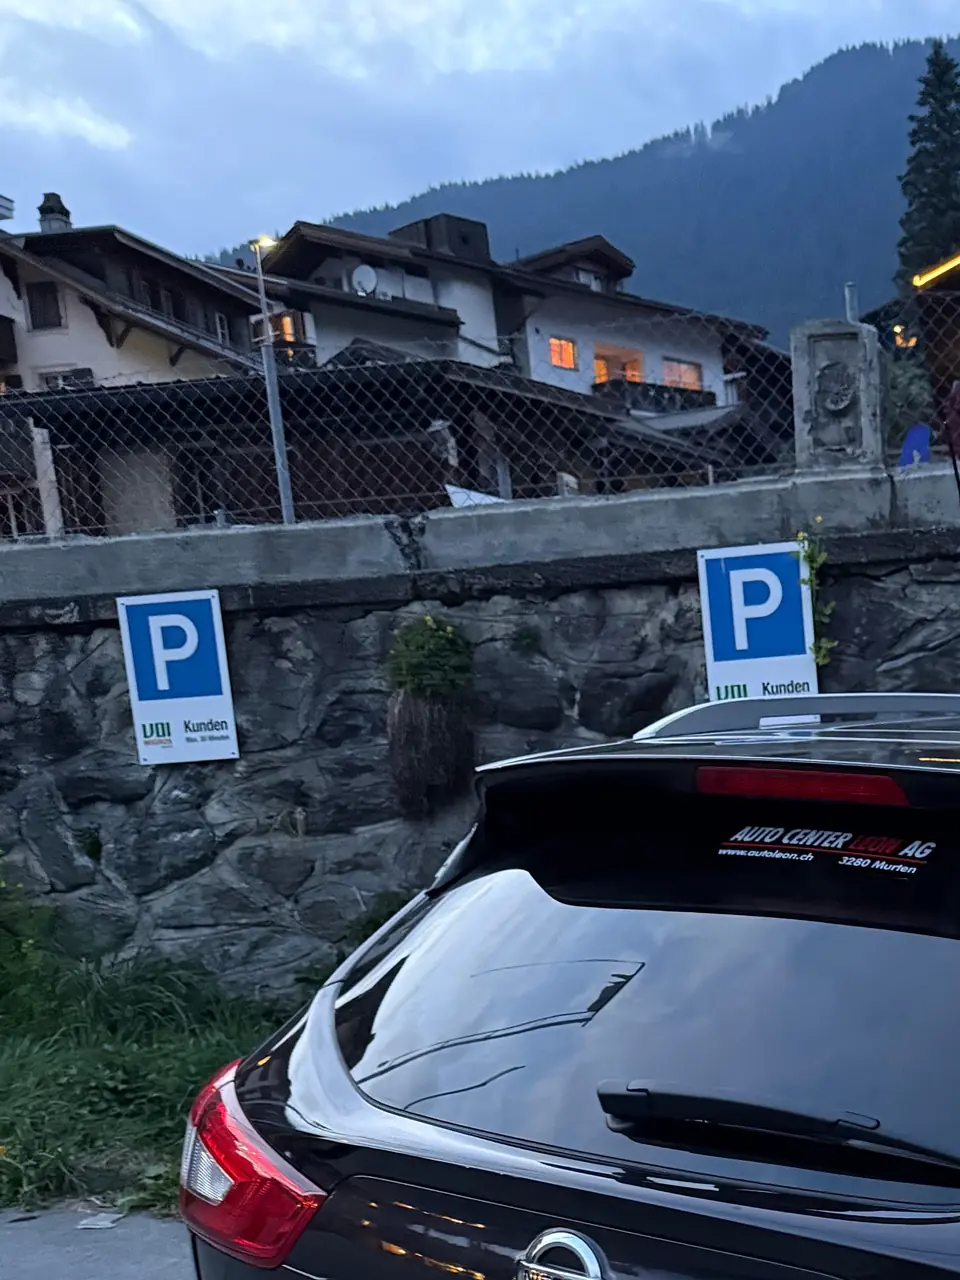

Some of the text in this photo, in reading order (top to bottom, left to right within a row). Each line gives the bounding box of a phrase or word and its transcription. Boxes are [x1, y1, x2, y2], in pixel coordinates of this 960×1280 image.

[729, 567, 783, 651] P
[148, 613, 199, 691] P
[762, 680, 811, 696] Kunden
[183, 718, 229, 734] Kunden
[729, 825, 937, 859] AUTO CENTER LEON AG
[717, 847, 815, 862] www.autoleon.ch
[837, 856, 918, 875] 3280 Murten
